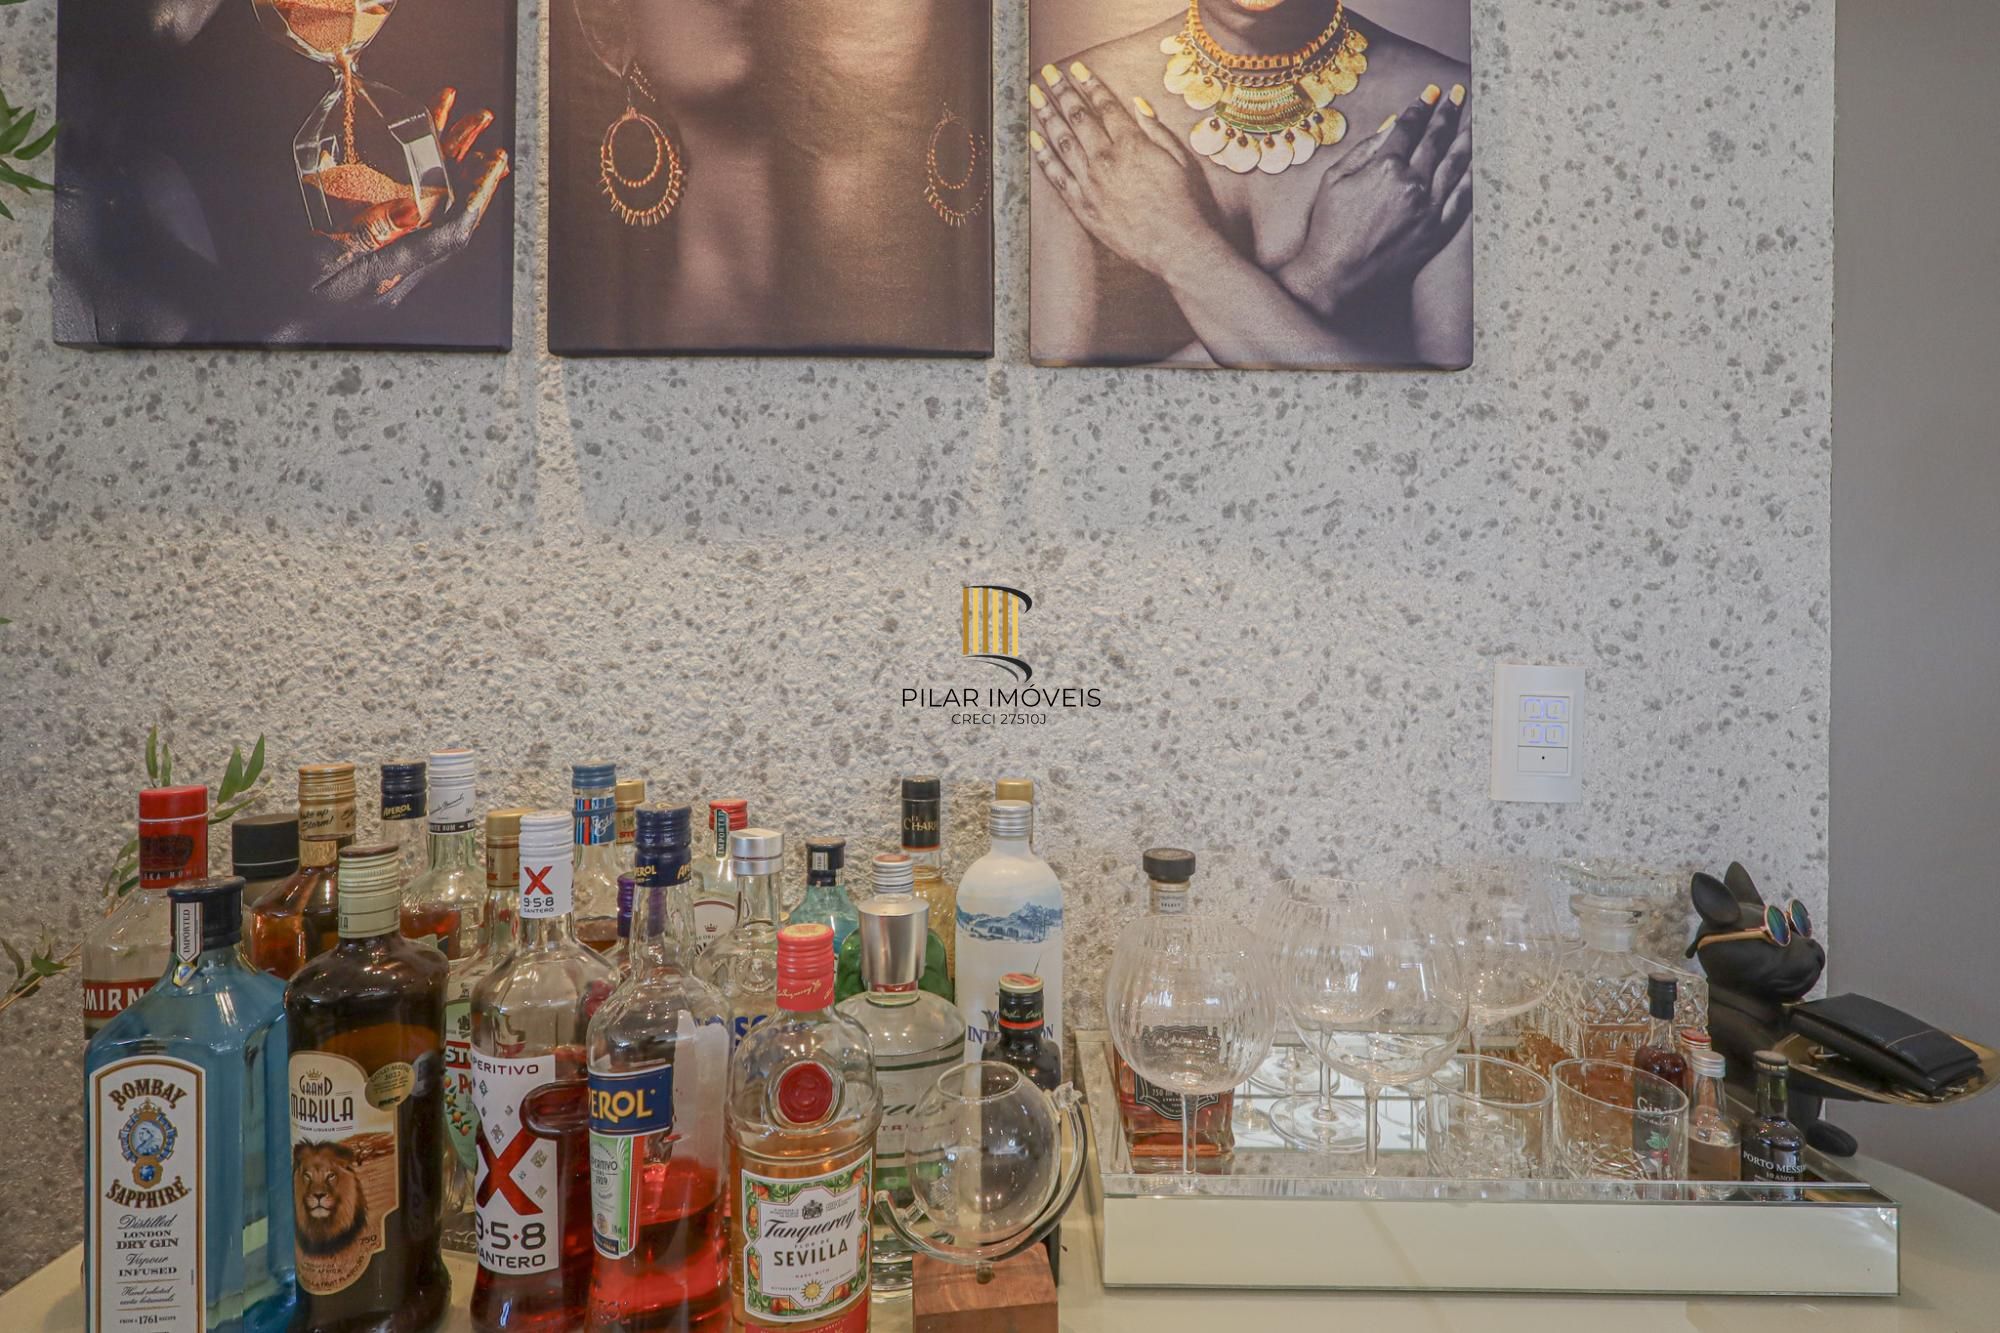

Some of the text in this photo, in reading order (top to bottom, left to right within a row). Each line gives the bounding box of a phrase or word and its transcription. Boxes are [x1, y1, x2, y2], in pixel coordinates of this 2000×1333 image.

[523, 865, 553, 896] X
[183, 908, 191, 954] IMPORTED
[108, 1078, 187, 1111] BOMBAY
[299, 1075, 333, 1097] GRAND
[290, 1093, 354, 1124] MARULA
[590, 1088, 653, 1124] EROL
[1743, 1150, 1775, 1170] PORTO
[105, 1175, 189, 1209] SAPPHIRE
[117, 1213, 178, 1230] Distilled
[764, 1208, 857, 1244] Tanqueray
[115, 1238, 179, 1250] DRY GIN
[123, 1230, 172, 1239] LONDON
[125, 1252, 168, 1267] Vapour
[773, 1238, 848, 1267] SEVILLA
[119, 1267, 177, 1277] INFUSED
[139, 1315, 158, 1325] 1761
